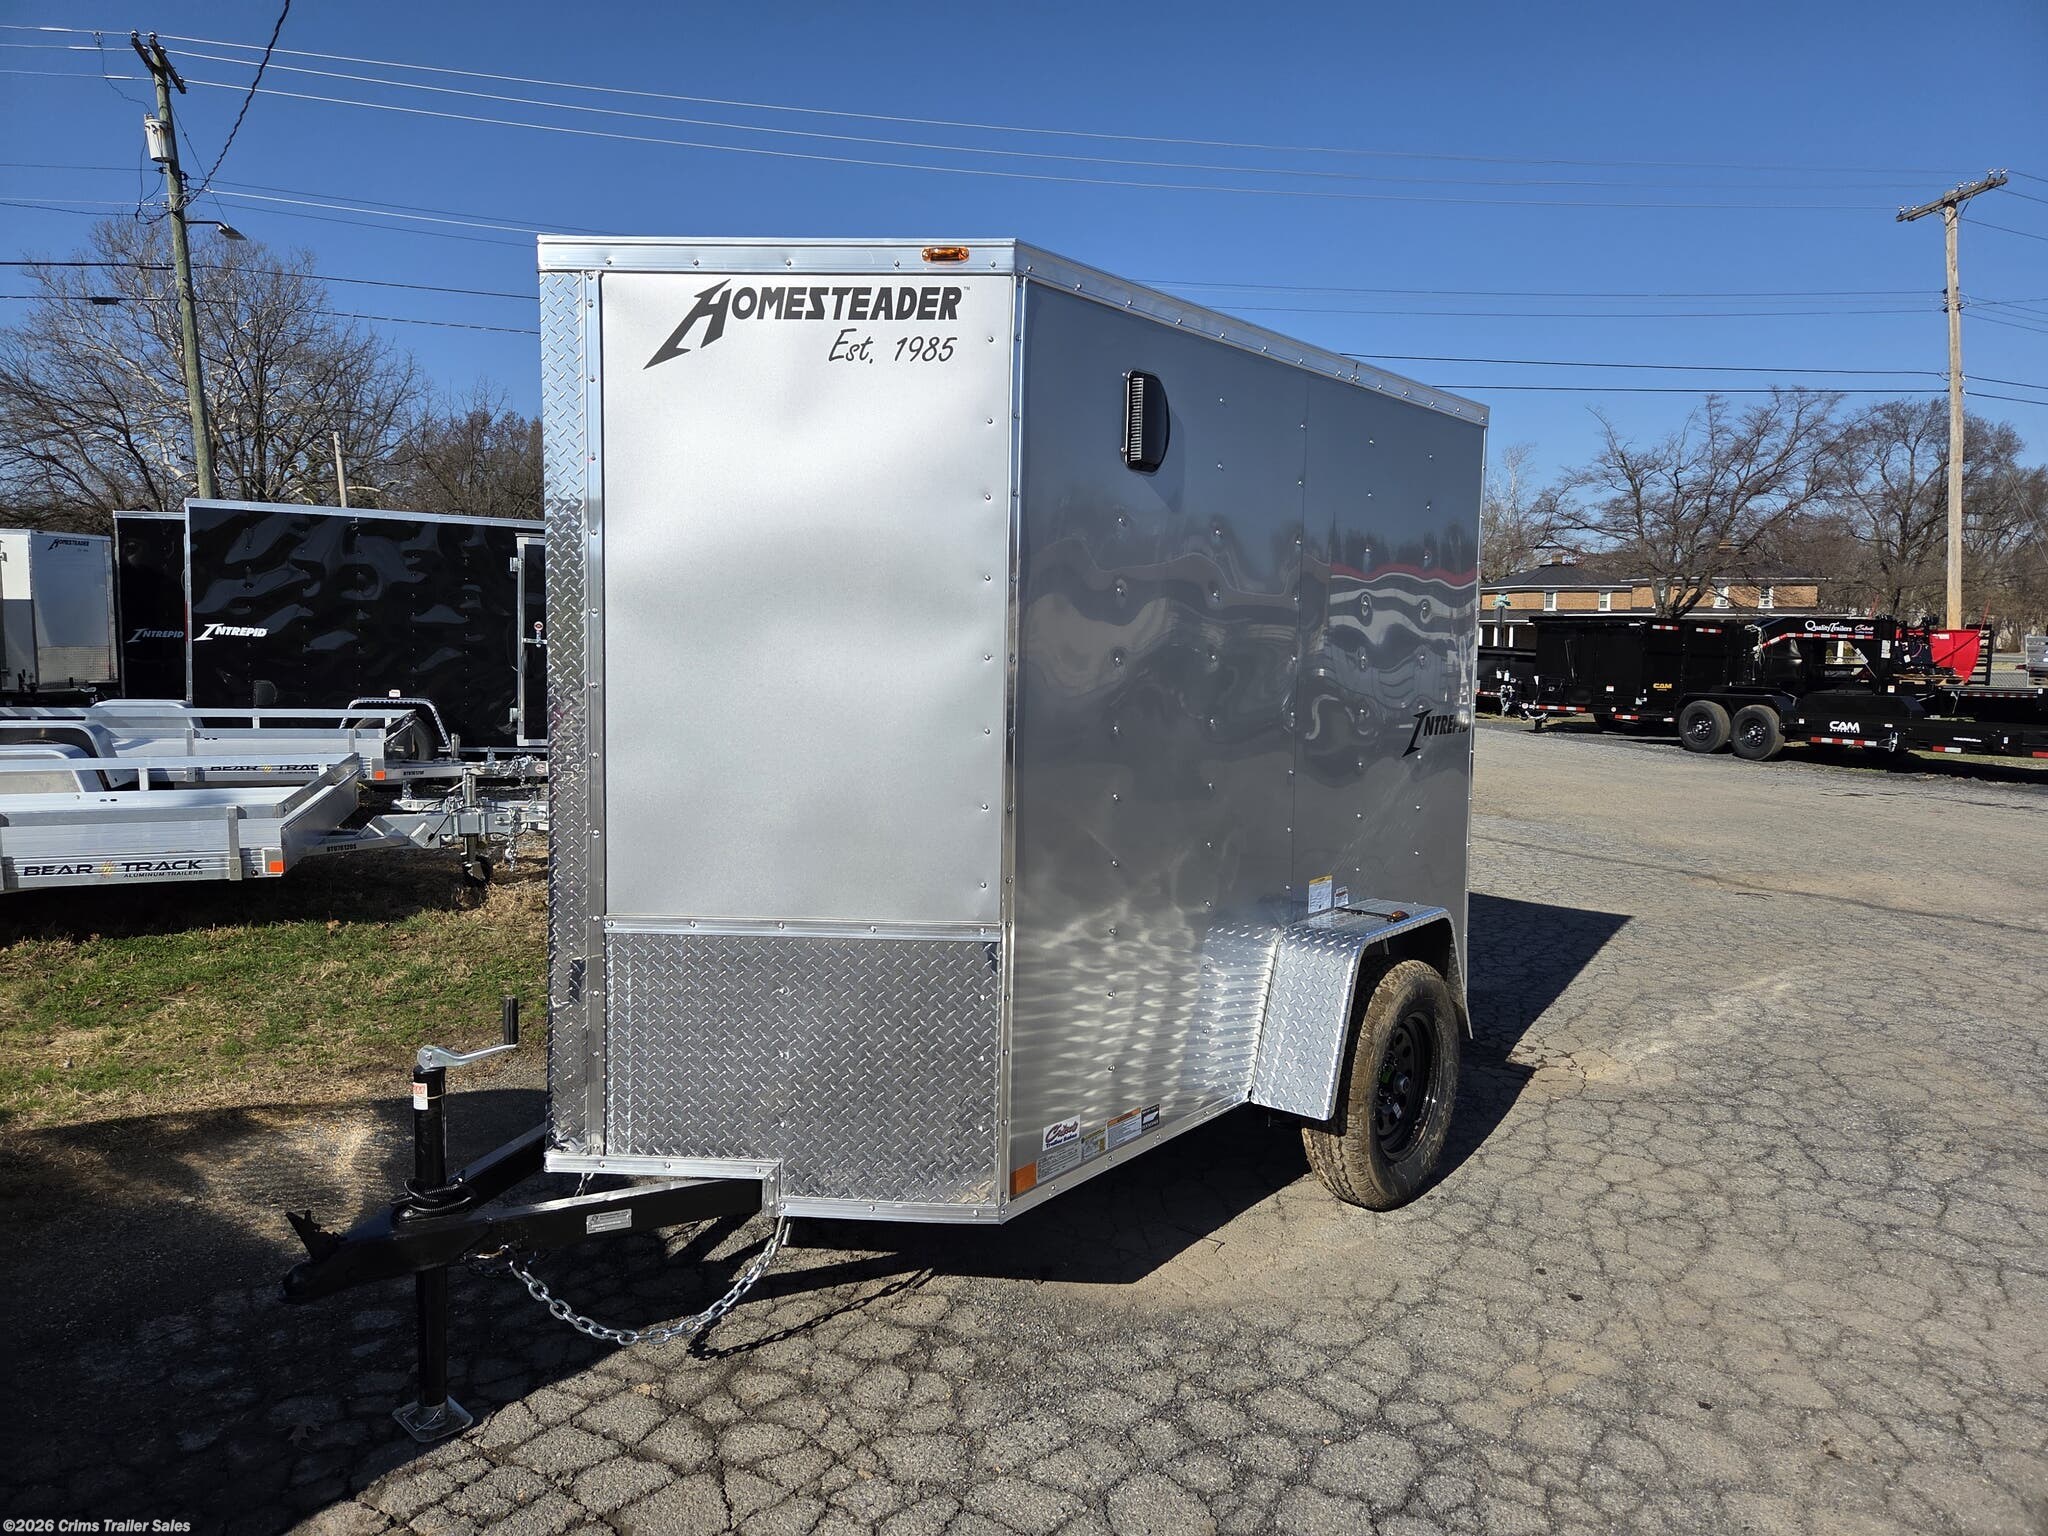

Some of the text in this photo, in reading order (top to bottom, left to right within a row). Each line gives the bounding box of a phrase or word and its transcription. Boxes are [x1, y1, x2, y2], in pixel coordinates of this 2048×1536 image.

[895, 336, 957, 362] 1985
[126, 628, 184, 643] INTREPID
[193, 623, 268, 641] INTREPID
[1829, 721, 1860, 734] CAM
[24, 859, 202, 876] BEAR TRACK
